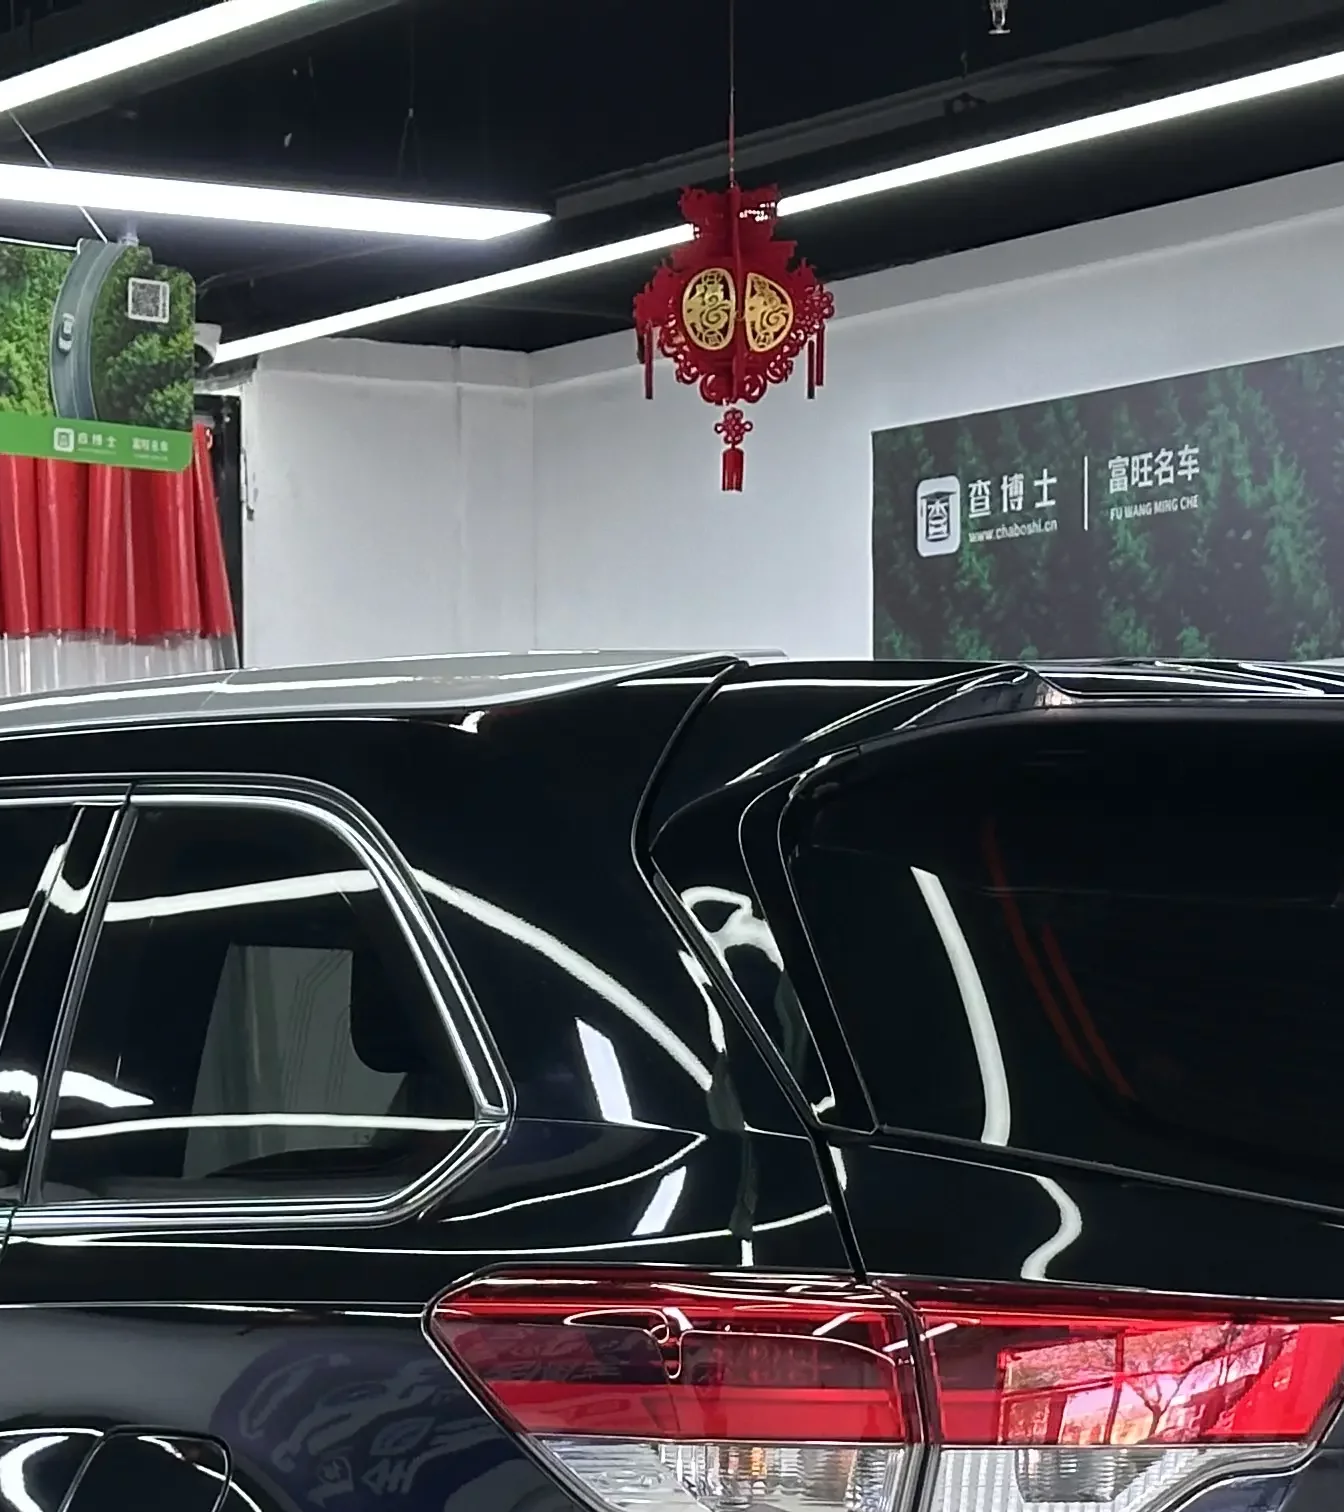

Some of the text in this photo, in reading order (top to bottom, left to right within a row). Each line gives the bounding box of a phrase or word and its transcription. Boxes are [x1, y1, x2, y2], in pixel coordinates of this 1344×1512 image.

[1108, 444, 1200, 494] 富旺名车
[968, 468, 1058, 519] 查博士
[1110, 494, 1199, 521] FU WANG MING CHE
[968, 518, 1058, 543] www.chaboshi.cn
